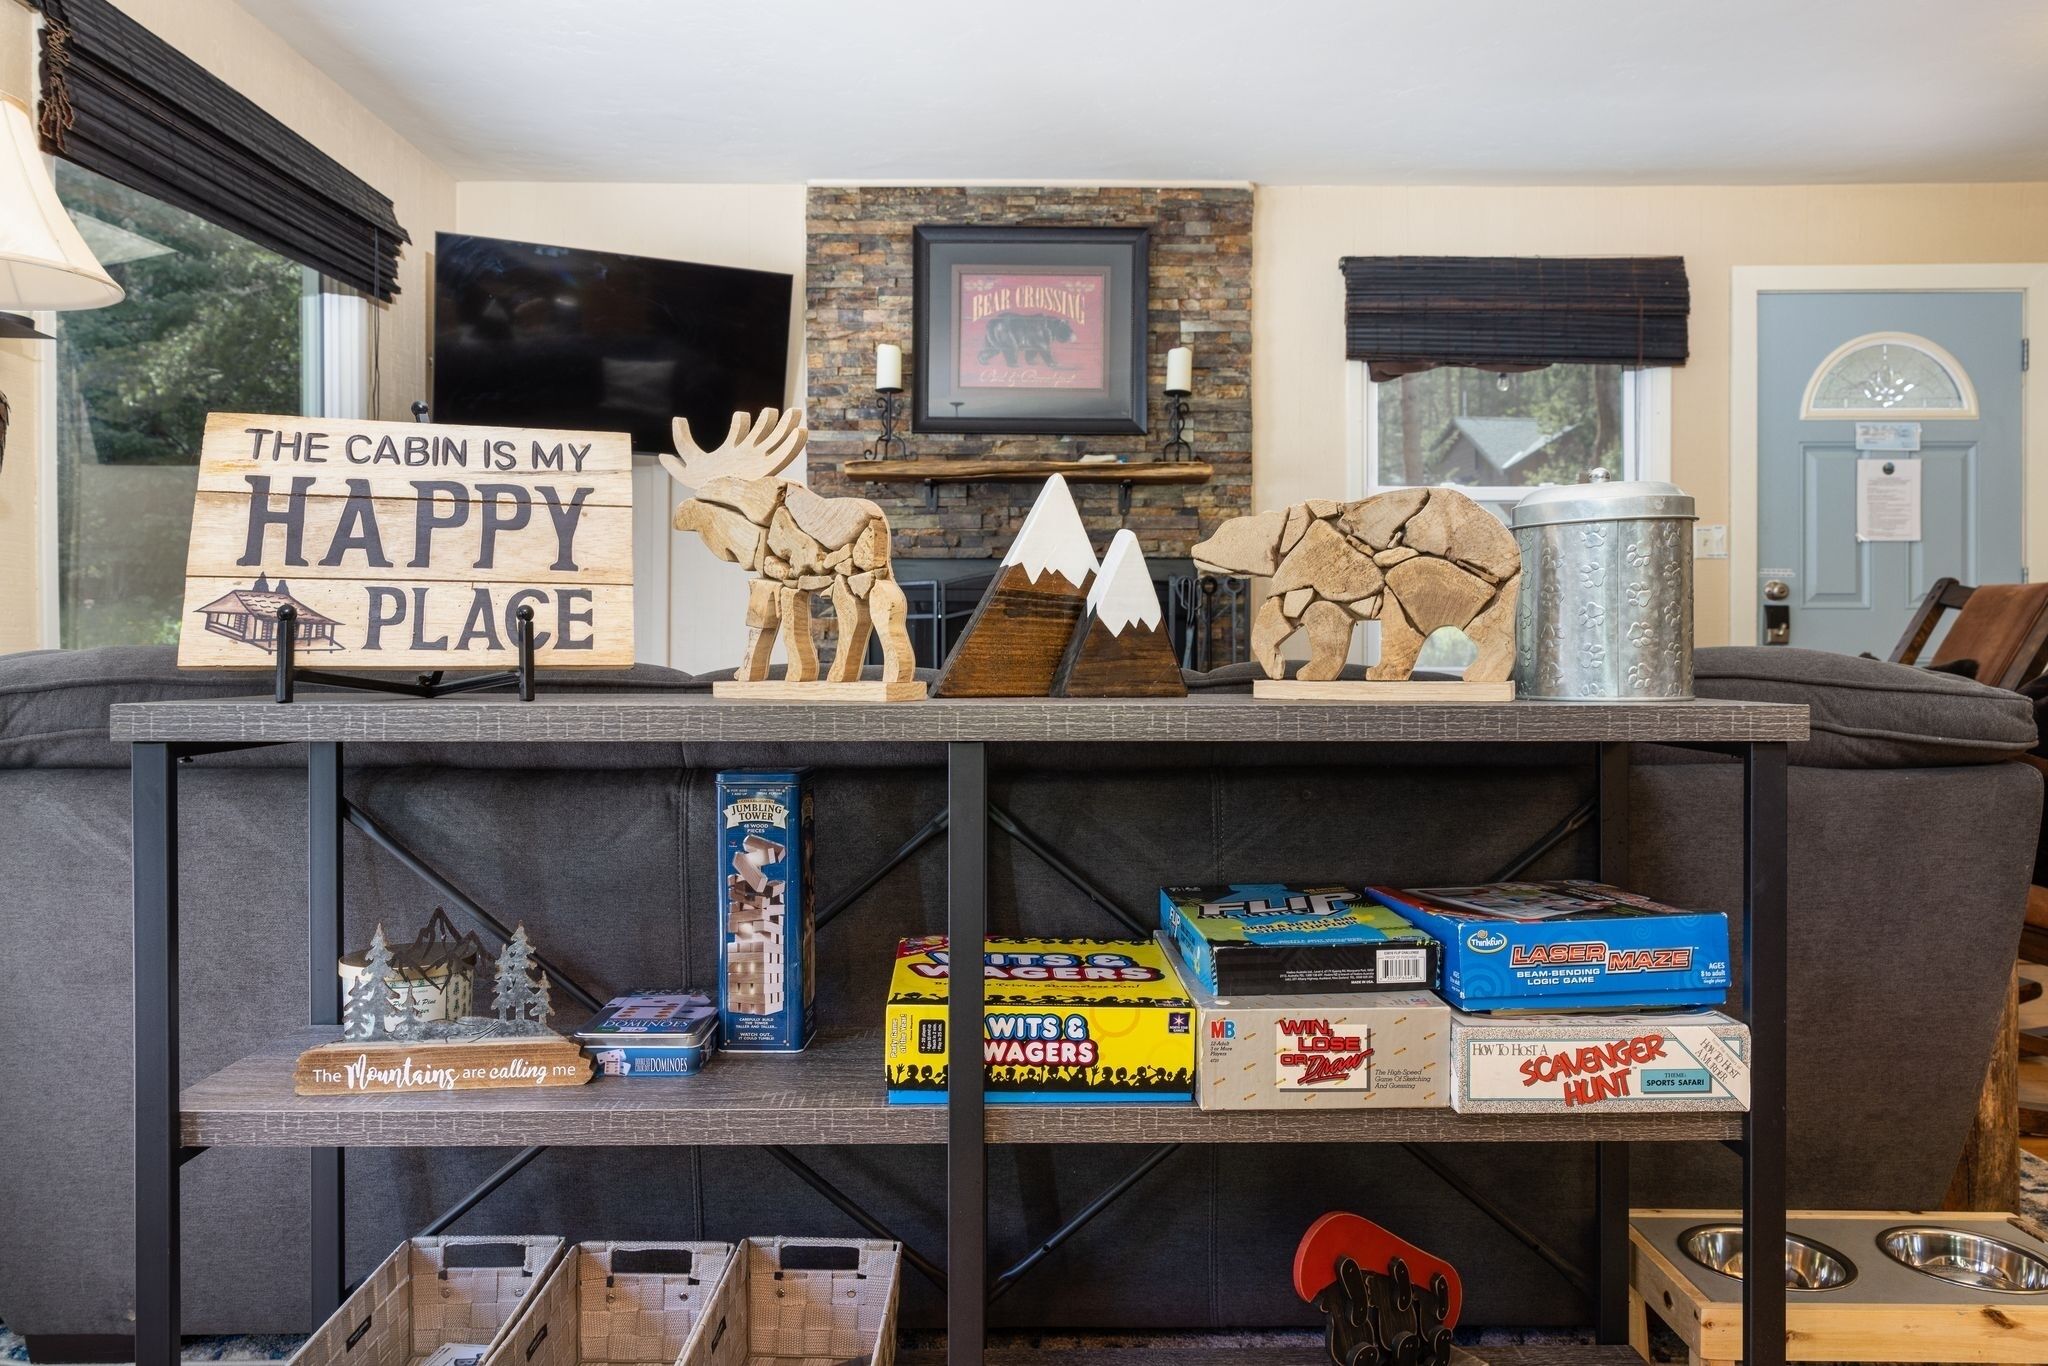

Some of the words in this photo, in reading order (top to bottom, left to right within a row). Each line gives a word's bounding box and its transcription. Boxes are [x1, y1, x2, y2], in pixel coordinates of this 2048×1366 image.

[972, 288, 1011, 323] BEAR
[1015, 285, 1086, 325] CROSSING
[245, 428, 330, 463] THE
[345, 434, 468, 468] CABIN
[483, 439, 517, 471] IS
[531, 440, 592, 473] MY
[236, 475, 595, 573] HAPPY
[361, 586, 594, 651] PLACE
[731, 803, 782, 815] JUMBLING
[739, 812, 774, 821] TOWER
[1201, 892, 1361, 916] FLIP
[1093, 955, 1126, 966] &
[1512, 944, 1606, 965] LASER
[1608, 949, 1691, 970] MAZE
[1516, 968, 1600, 978] BEAM-BENDING
[1527, 977, 1560, 985] LOGIC
[1563, 976, 1594, 984] GAME
[602, 1019, 689, 1027] DOMINOES
[987, 1015, 1061, 1039] WITS
[1067, 1015, 1087, 1039] &
[1211, 1020, 1236, 1039] MB
[1279, 1019, 1334, 1037] WIN,
[984, 1042, 1094, 1064] WAGERS
[1297, 1036, 1362, 1052] LOSE
[1540, 1043, 1548, 1056] A
[650, 1057, 688, 1072] DOMINOES
[1280, 1053, 1308, 1066] OR
[1297, 1048, 1375, 1085] Draw
[1519, 1033, 1668, 1087] SCAVENGER
[313, 1069, 341, 1083] The
[344, 1053, 460, 1090] Mountains
[462, 1068, 486, 1079] are
[489, 1058, 549, 1083] calling
[552, 1063, 576, 1075] me
[1563, 1068, 1633, 1107] HUNT
